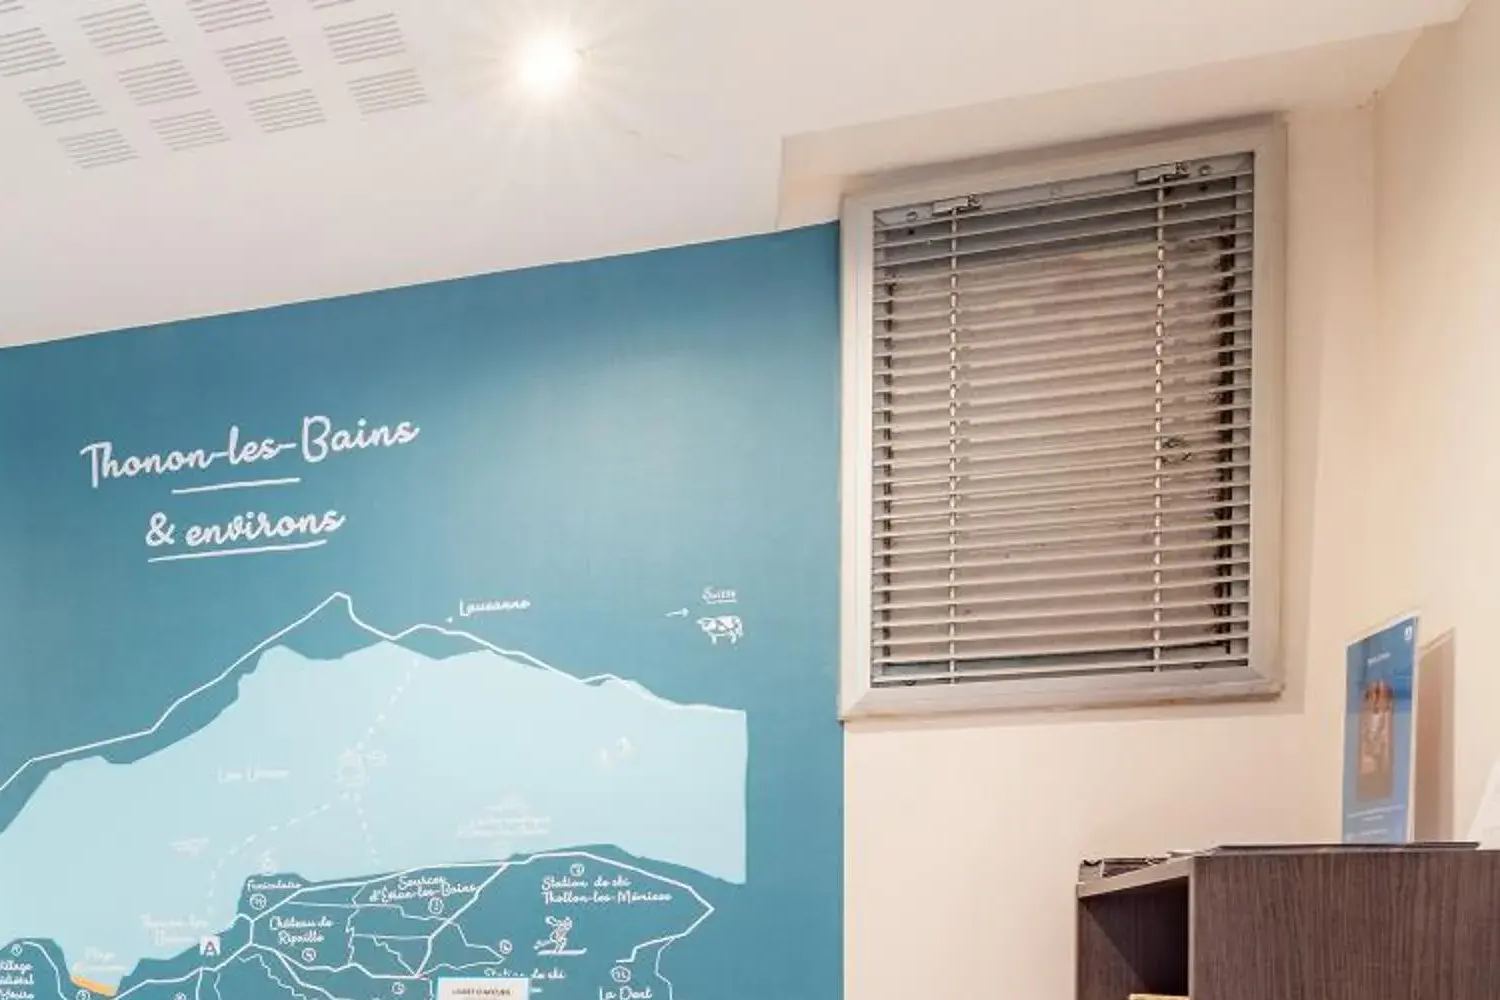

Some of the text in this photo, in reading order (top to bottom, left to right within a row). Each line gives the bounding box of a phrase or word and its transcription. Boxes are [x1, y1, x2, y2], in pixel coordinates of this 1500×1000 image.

[80, 415, 420, 488] Thonon-les-Bains
[145, 508, 347, 547] & environs
[619, 987, 652, 1000] Dent
